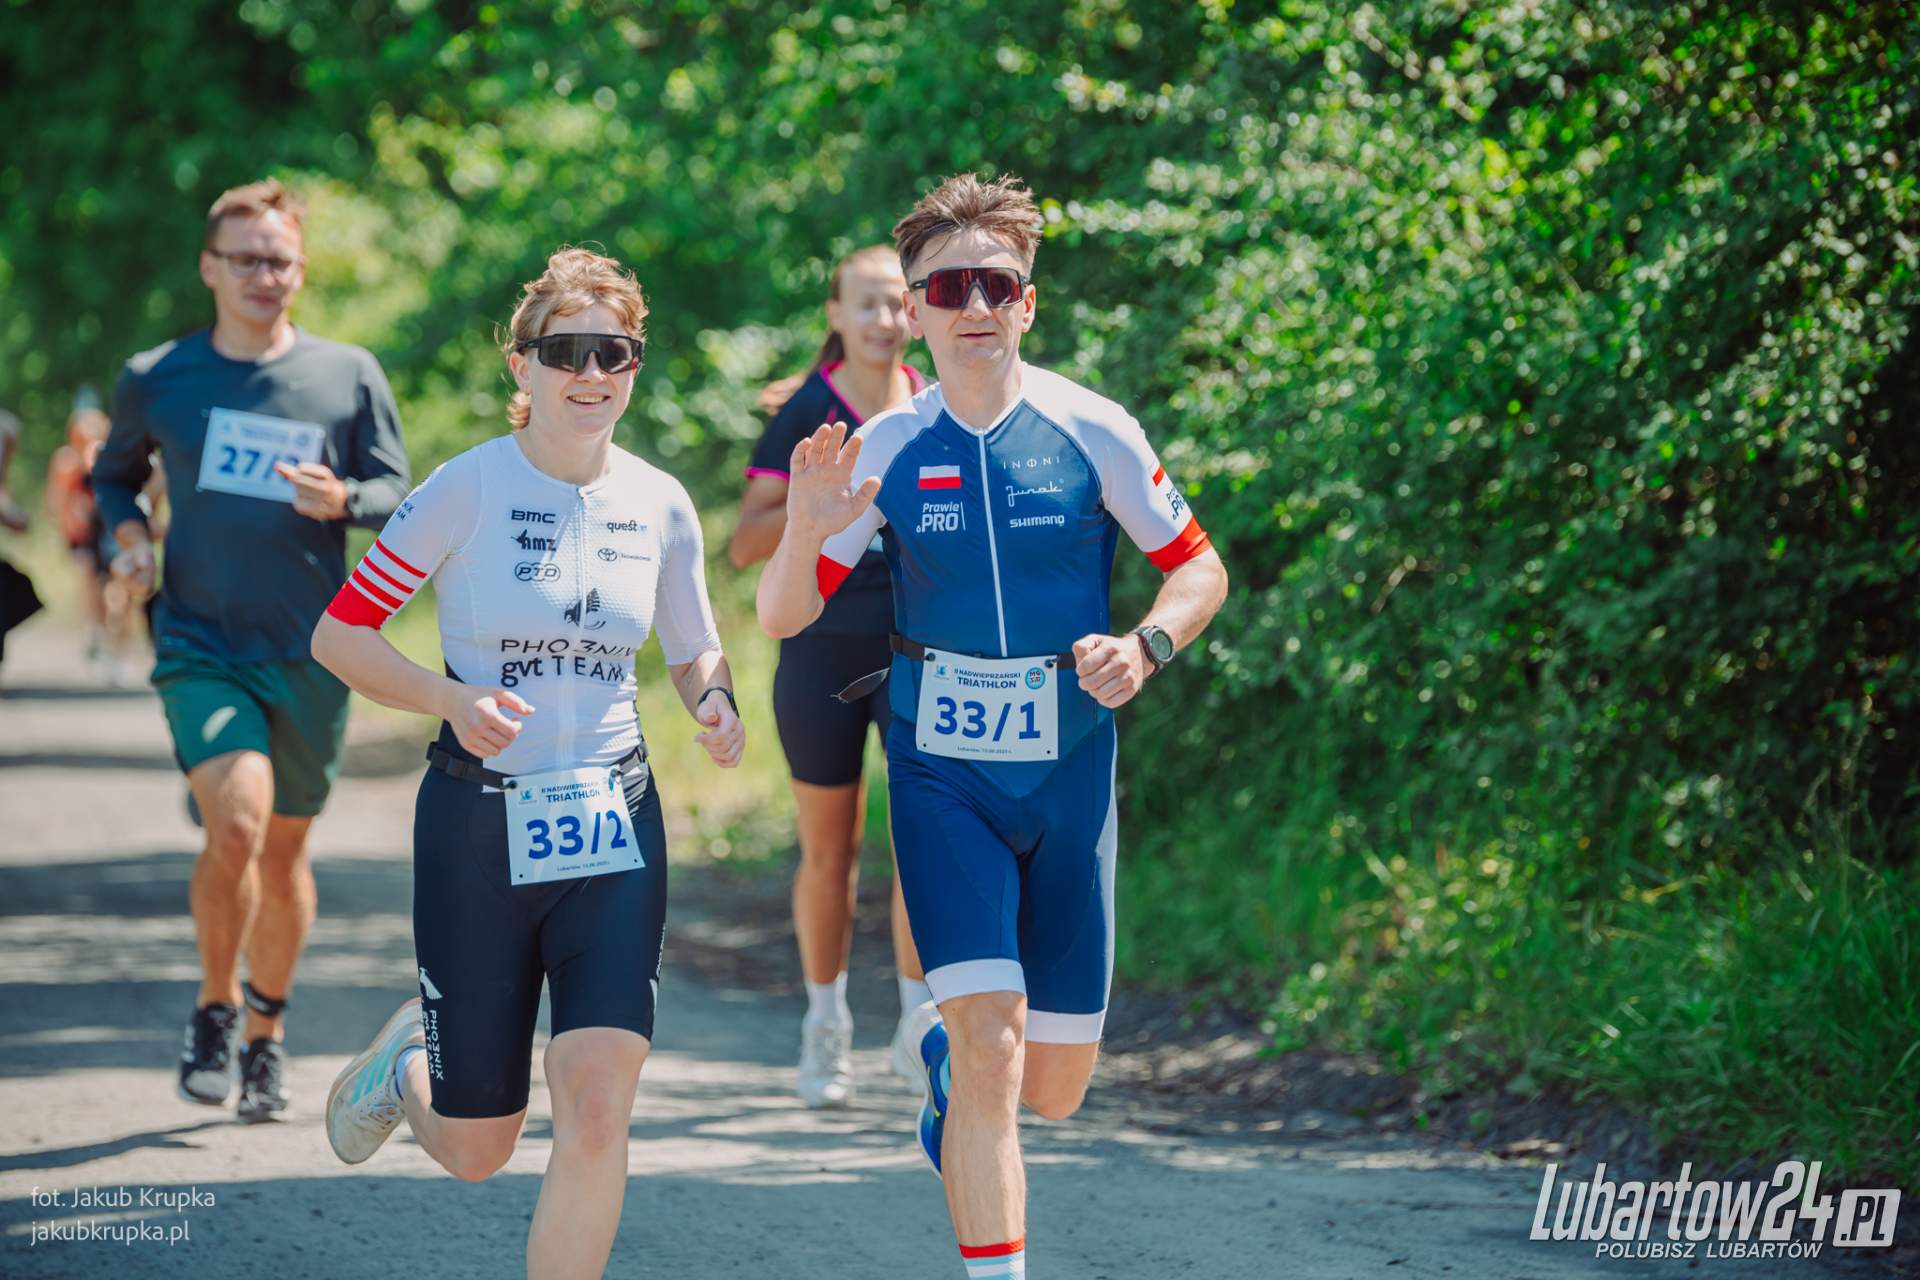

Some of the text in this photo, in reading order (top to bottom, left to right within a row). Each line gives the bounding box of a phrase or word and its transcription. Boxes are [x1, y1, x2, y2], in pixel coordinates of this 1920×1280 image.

[922, 501, 960, 513] Prawie
[510, 509, 556, 524] BMC
[1009, 515, 1065, 529] SHIMANO
[606, 519, 637, 533] quest
[551, 655, 624, 681] TEAM
[957, 676, 1017, 689] TRIATHLON
[934, 696, 1041, 742] 33/1
[526, 809, 628, 860] 33/2
